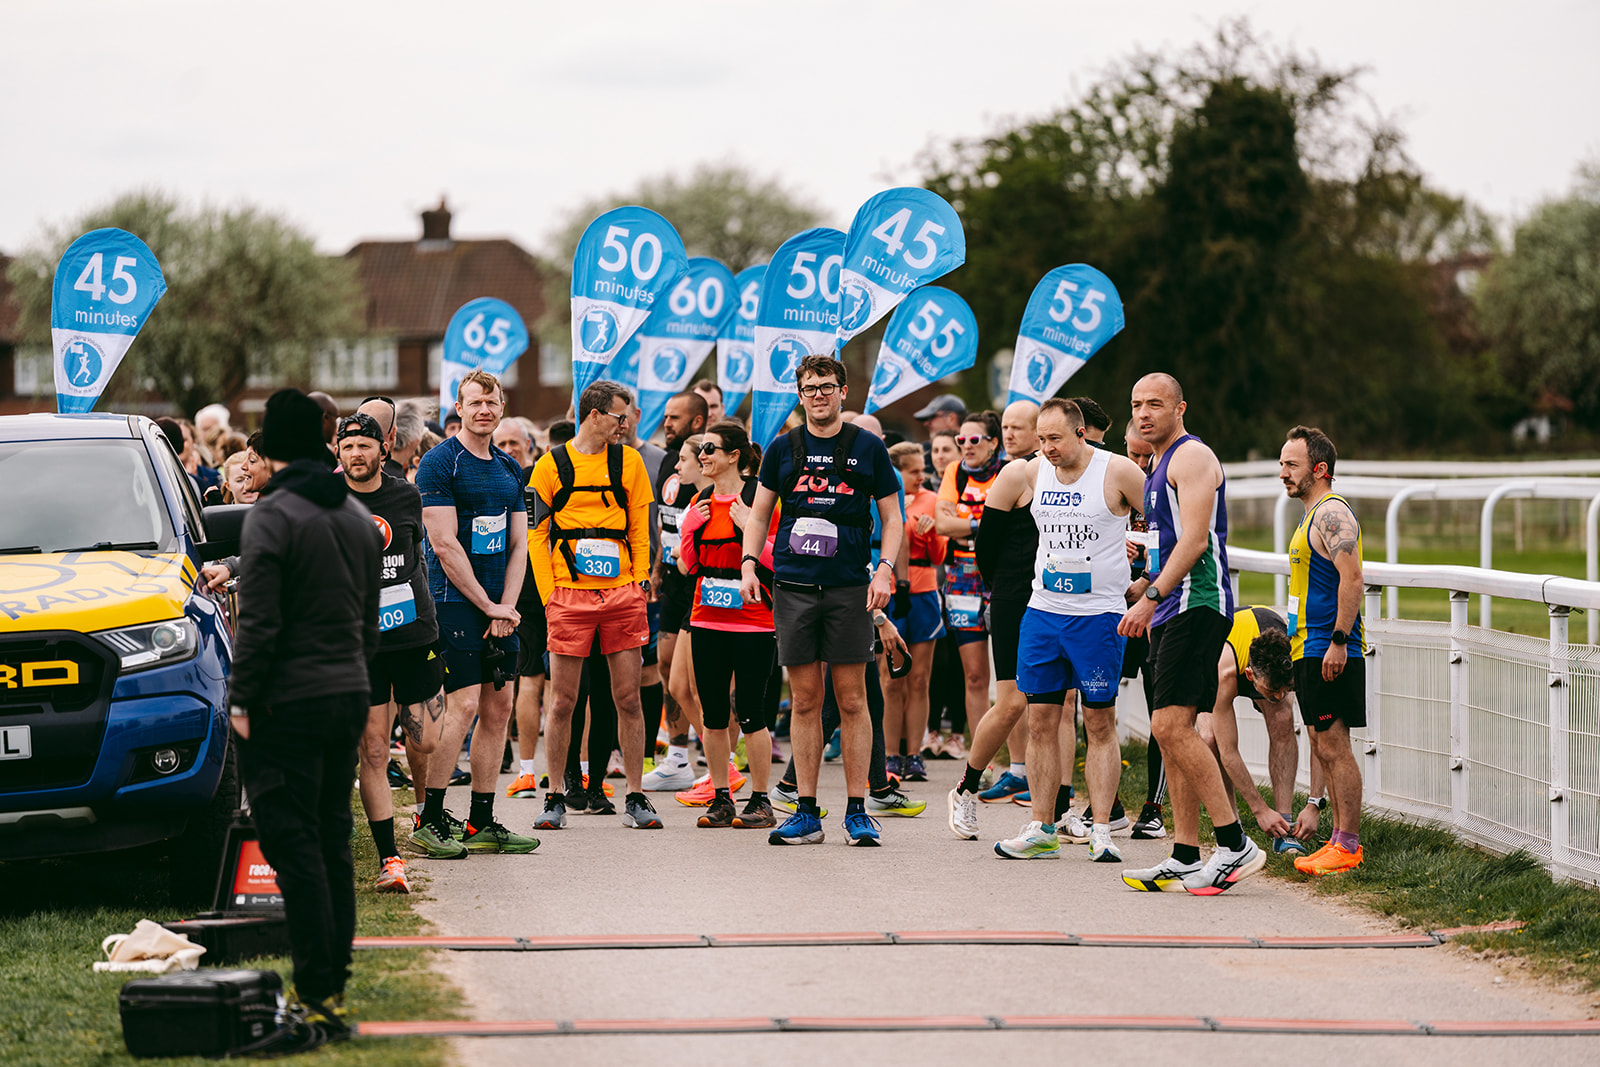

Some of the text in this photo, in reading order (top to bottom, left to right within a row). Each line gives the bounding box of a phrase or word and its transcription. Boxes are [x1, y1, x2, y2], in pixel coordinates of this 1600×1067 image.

[872, 208, 945, 269] 45
[598, 225, 663, 281] 50
[74, 252, 137, 304] 45
[786, 252, 843, 303] 50
[861, 255, 917, 288] minute
[595, 277, 654, 304] minutes
[669, 276, 724, 318] 60
[738, 280, 759, 320] 6
[76, 306, 137, 328] minutes
[784, 304, 839, 326] minute
[1048, 279, 1106, 333] 55
[463, 312, 511, 355] 65
[666, 320, 718, 336] minutes
[908, 299, 965, 358] 55
[1042, 325, 1092, 354] minutes
[897, 338, 938, 377] minutes
[1042, 492, 1070, 505] NHS
[1044, 524, 1093, 533] LITTLE
[1066, 532, 1099, 541] TOO
[487, 537, 502, 552] 44
[801, 539, 820, 554] 44
[1050, 541, 1085, 549] LATE
[381, 568, 397, 579] SS
[585, 560, 612, 575] 330
[1054, 578, 1073, 592] 45
[0, 583, 168, 620] RADIO
[707, 590, 732, 606] 329
[950, 613, 969, 626] 328
[3, 730, 20, 754] L
